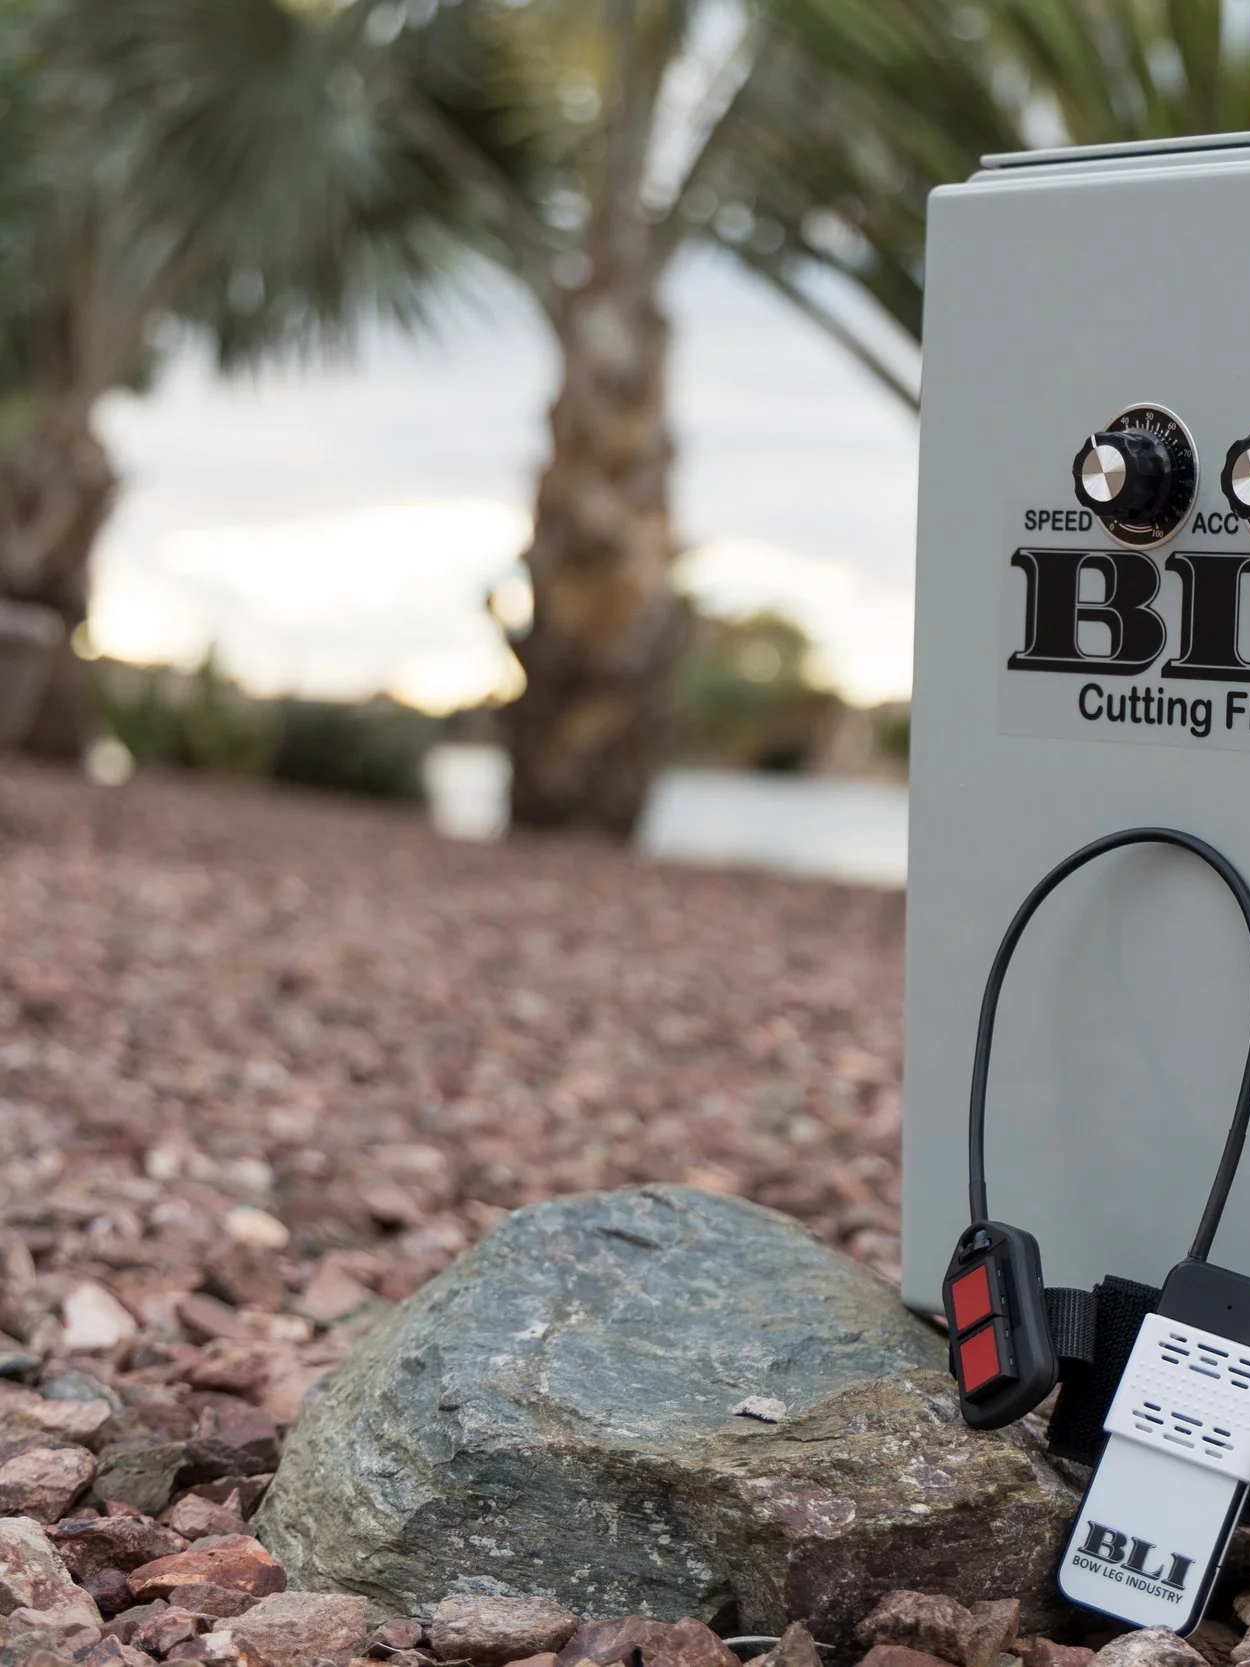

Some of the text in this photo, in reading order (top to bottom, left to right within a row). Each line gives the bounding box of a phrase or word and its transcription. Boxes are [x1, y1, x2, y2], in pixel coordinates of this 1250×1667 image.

[1120, 416, 1129, 425] 40
[1145, 412, 1154, 420] 50
[1167, 422, 1177, 431] 60
[1183, 449, 1192, 458] 70
[1024, 509, 1093, 531] SPEED
[1191, 512, 1240, 535] ACC
[1151, 529, 1164, 538] 100
[1078, 682, 1212, 738] Cutting
[1077, 1520, 1196, 1591] BLI
[1072, 1555, 1183, 1604] BOW LEG INDUSTRY
